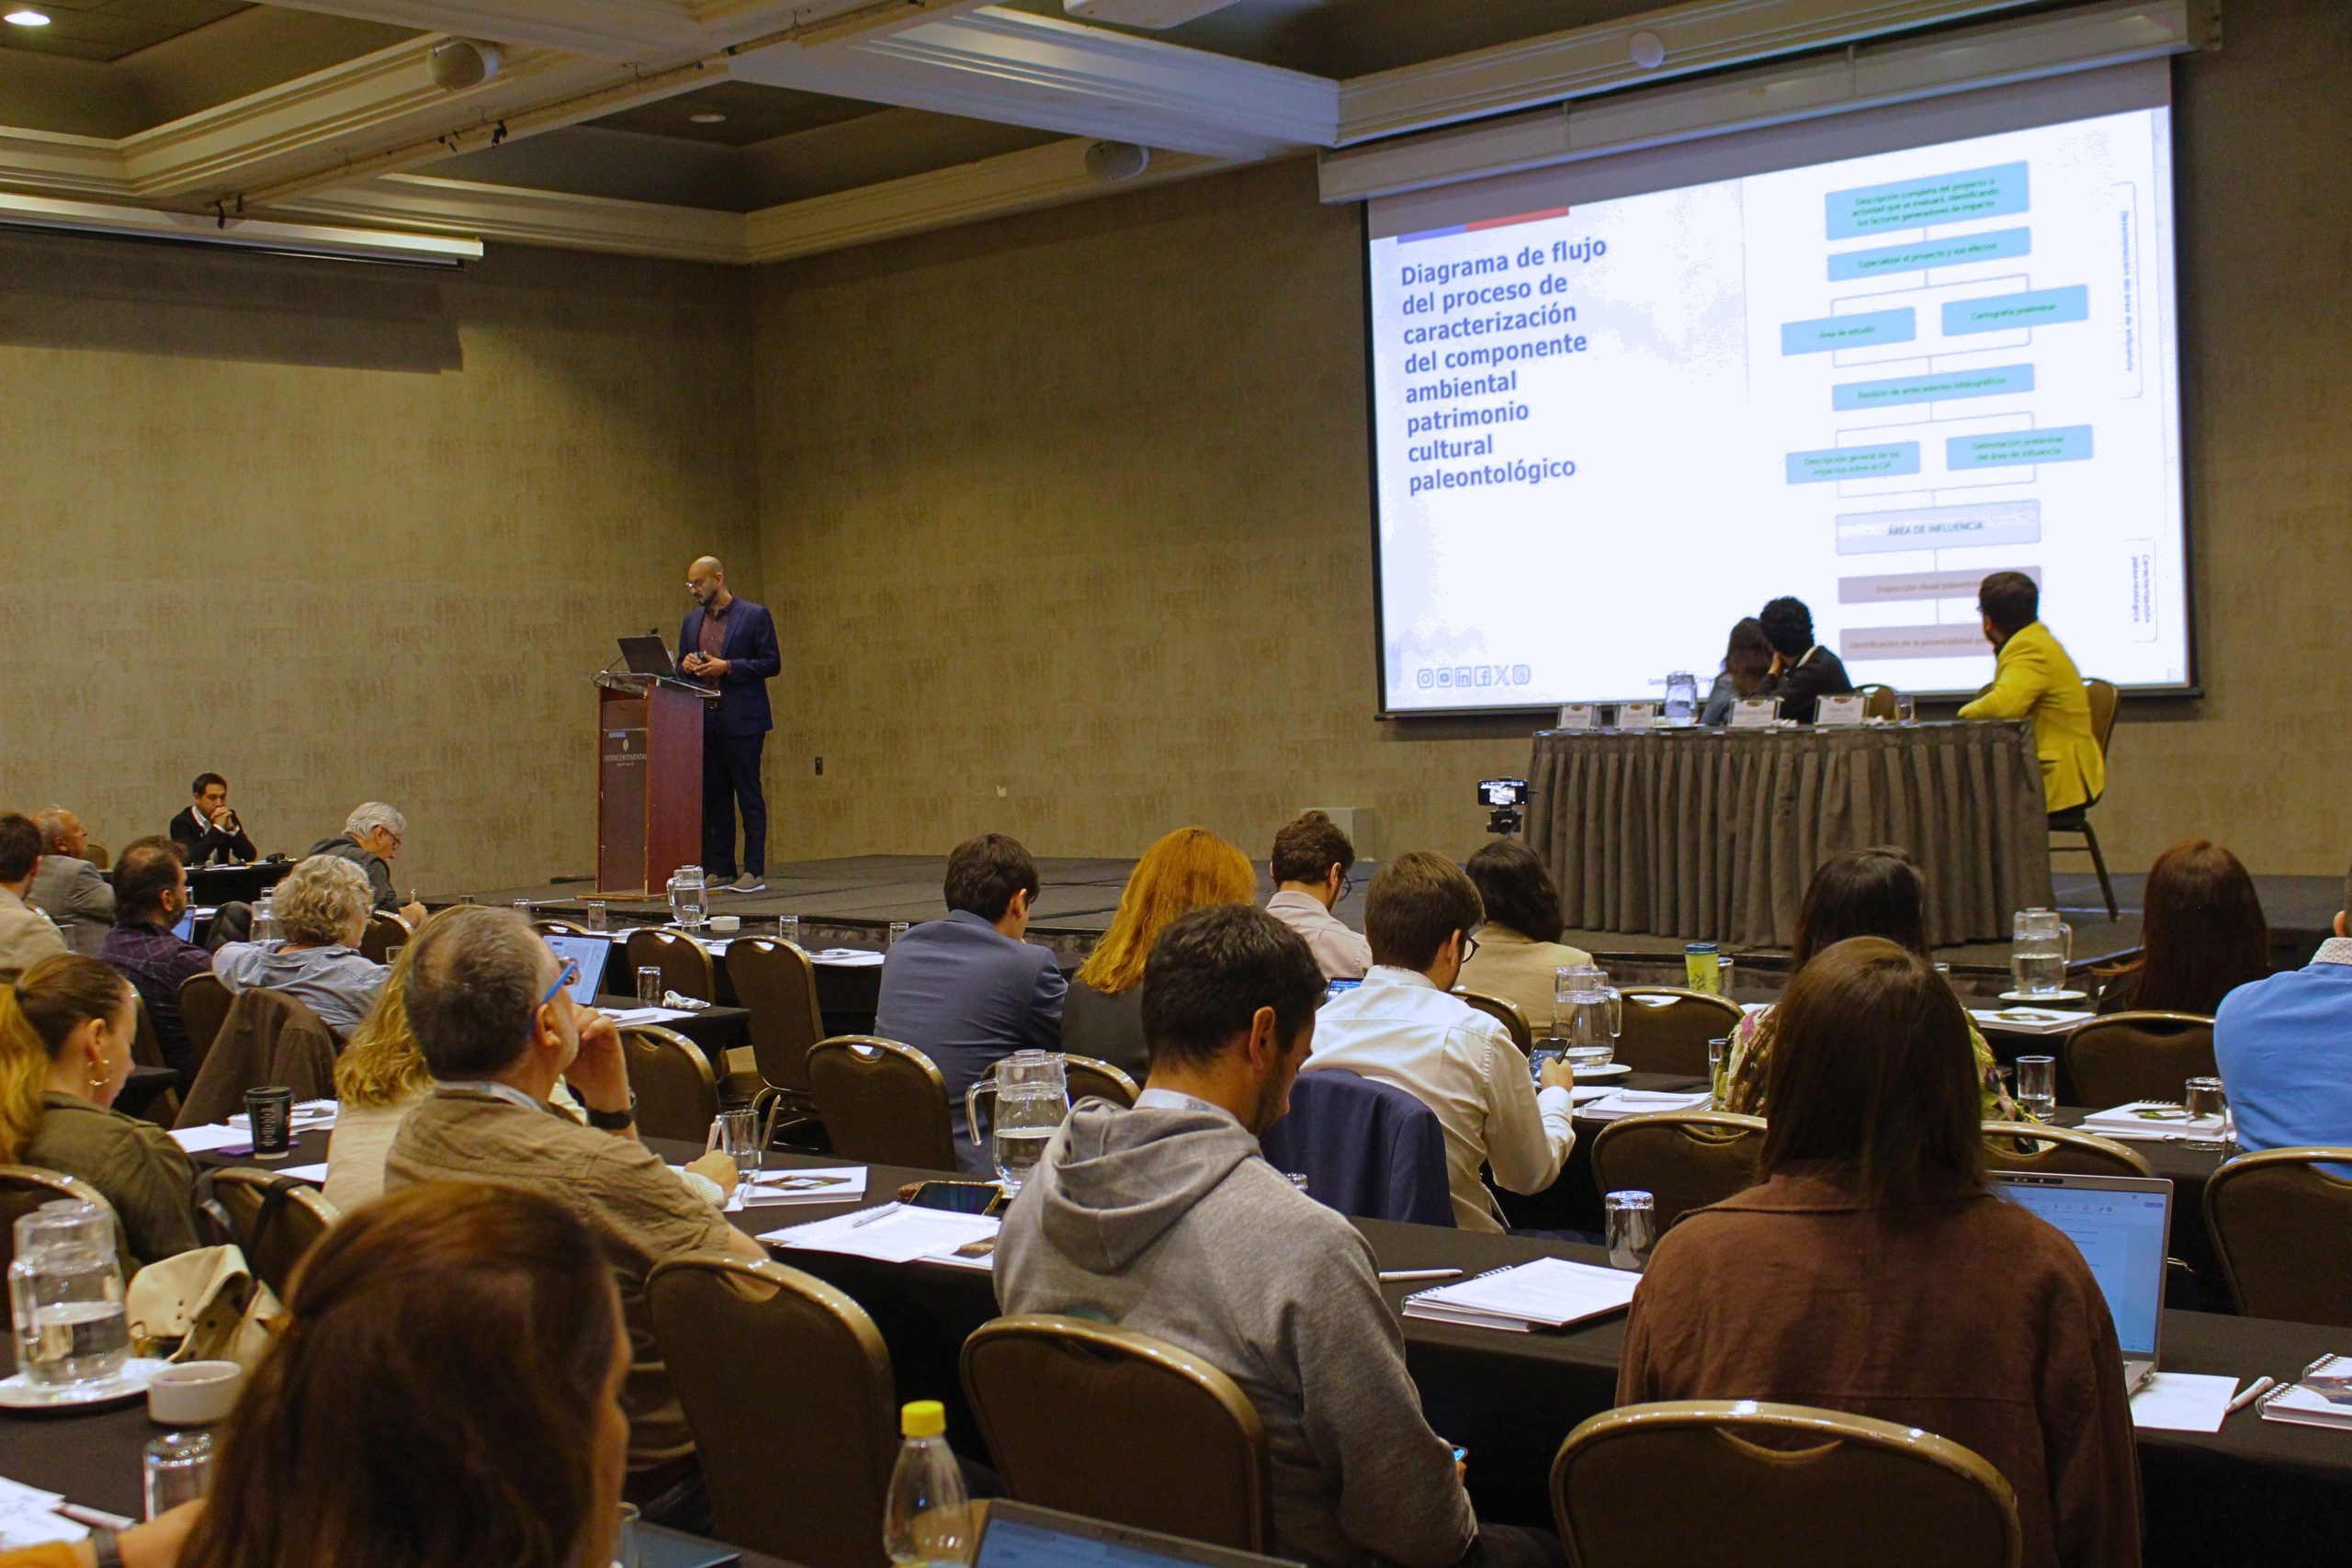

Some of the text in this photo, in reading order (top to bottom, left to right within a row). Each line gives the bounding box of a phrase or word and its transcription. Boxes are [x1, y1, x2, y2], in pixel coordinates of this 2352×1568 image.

[1401, 236, 1607, 287] Diagrama de flujo
[1402, 274, 1567, 315] del proceso de
[1403, 302, 1577, 344] caracterización
[1405, 333, 1588, 374] del componente
[1406, 370, 1518, 404] ambiental
[1408, 401, 1530, 438] patrimonio
[1408, 434, 1494, 462] cultural
[1409, 457, 1577, 497] paleontológico
[1914, 524, 1926, 535] DE
